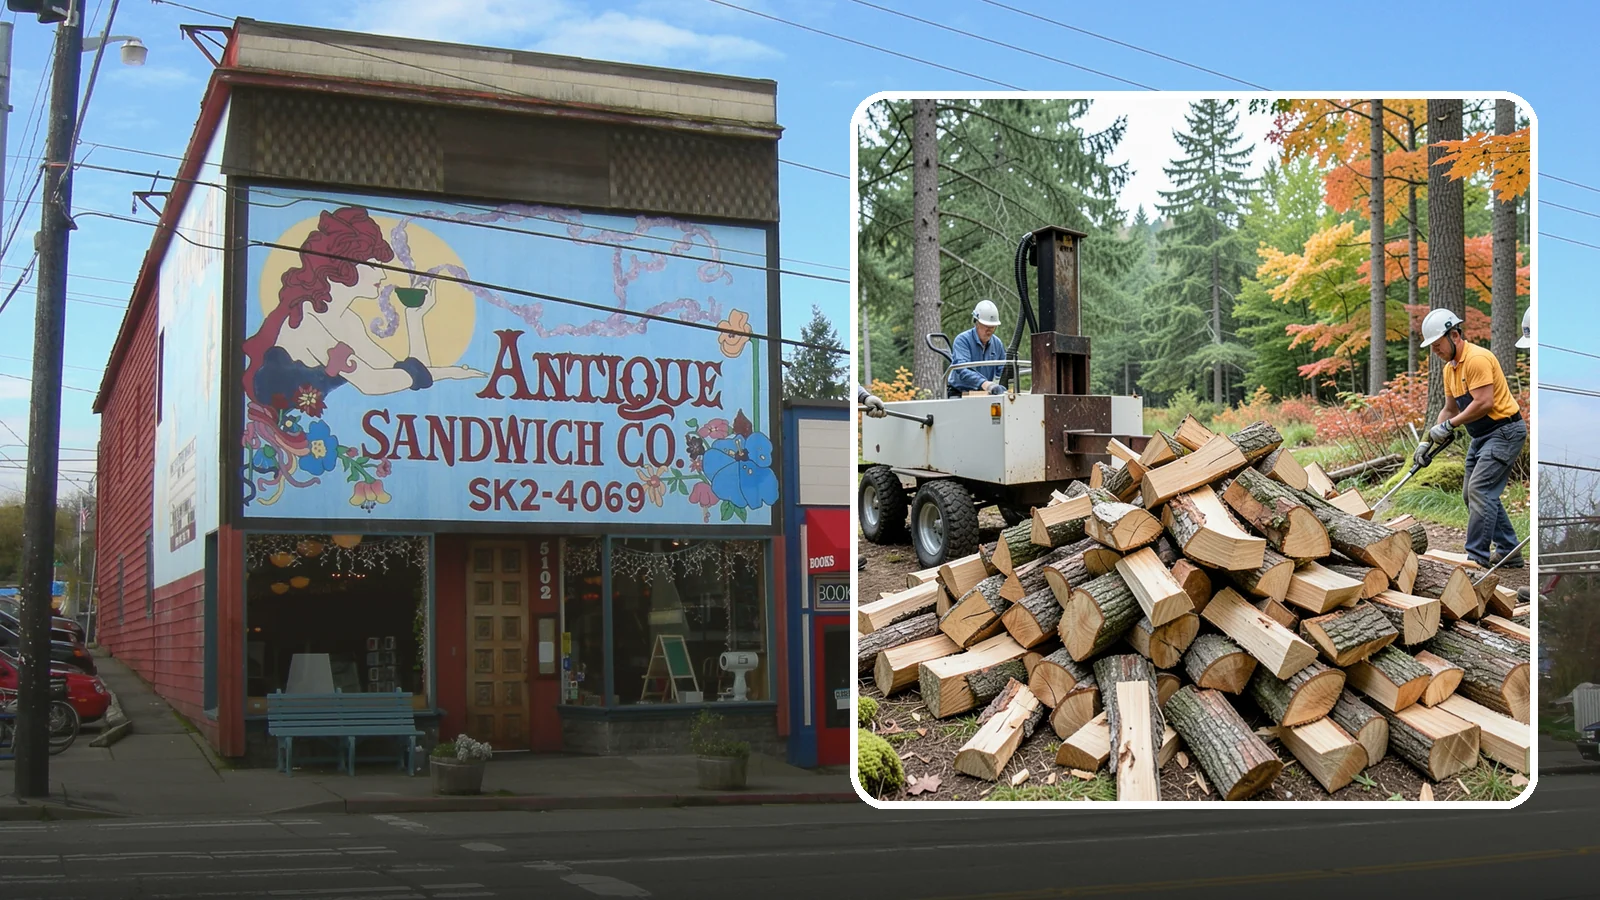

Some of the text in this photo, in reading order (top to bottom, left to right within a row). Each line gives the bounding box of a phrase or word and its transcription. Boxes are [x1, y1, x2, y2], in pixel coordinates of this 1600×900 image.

[476, 328, 723, 421] ANTIQUE
[361, 408, 685, 469] SANDWICH CO.
[468, 477, 646, 513] SK2-4069
[540, 541, 551, 600] 5102
[809, 554, 835, 569] BOOKS
